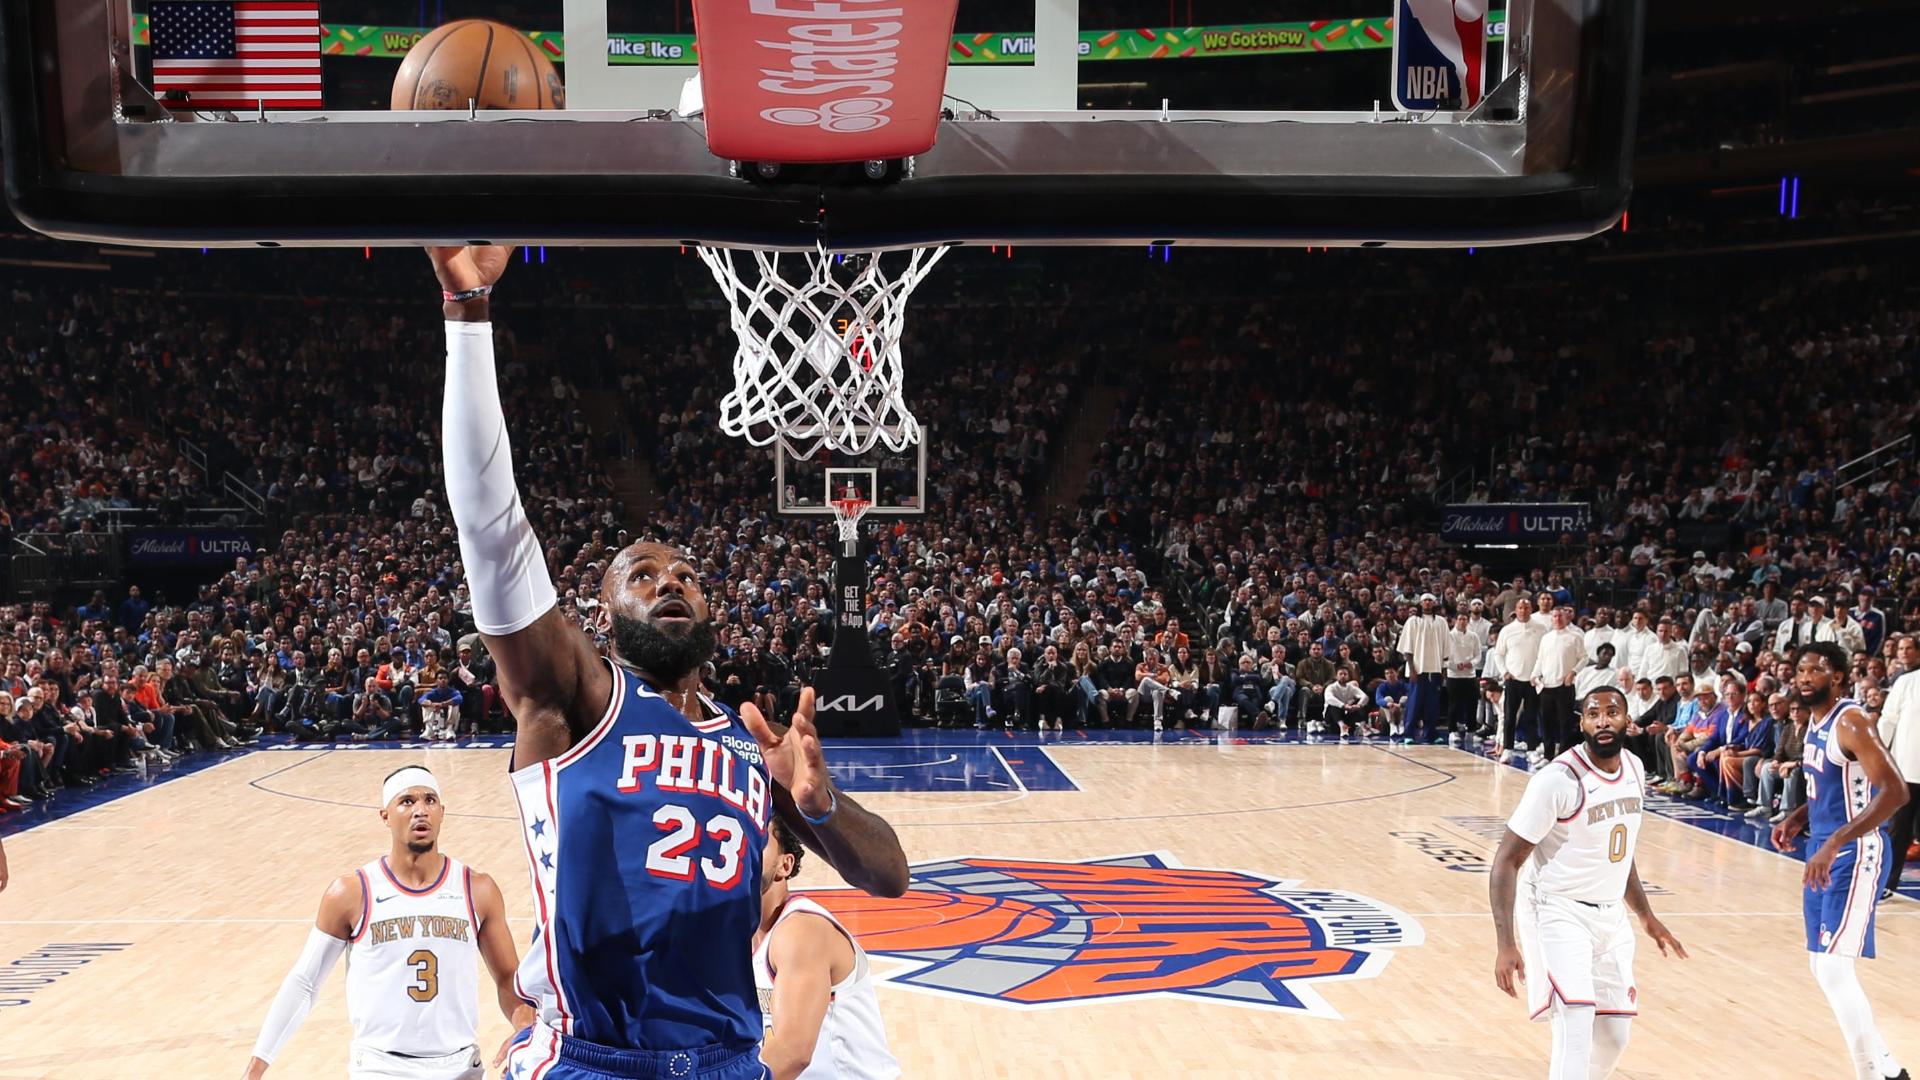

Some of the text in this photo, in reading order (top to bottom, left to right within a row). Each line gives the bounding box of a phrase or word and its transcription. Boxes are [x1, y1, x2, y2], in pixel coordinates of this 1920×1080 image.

[384, 34, 408, 48] We
[651, 41, 682, 58] Ike
[1203, 33, 1227, 49] We
[1407, 66, 1449, 99] NBA
[1441, 514, 1587, 533] Michelob ULTRA
[201, 540, 251, 553] ULTRA
[844, 586, 859, 598] GET
[845, 599, 860, 612] THE
[848, 613, 863, 627] App
[816, 694, 884, 712] KIA
[617, 734, 767, 834] PHILA
[1587, 800, 1615, 825] NEW
[645, 804, 747, 890] 23
[1608, 823, 1628, 863] 0
[370, 915, 470, 945] NEW YORK
[1321, 914, 1402, 945] YORK
[407, 949, 439, 1002] 3
